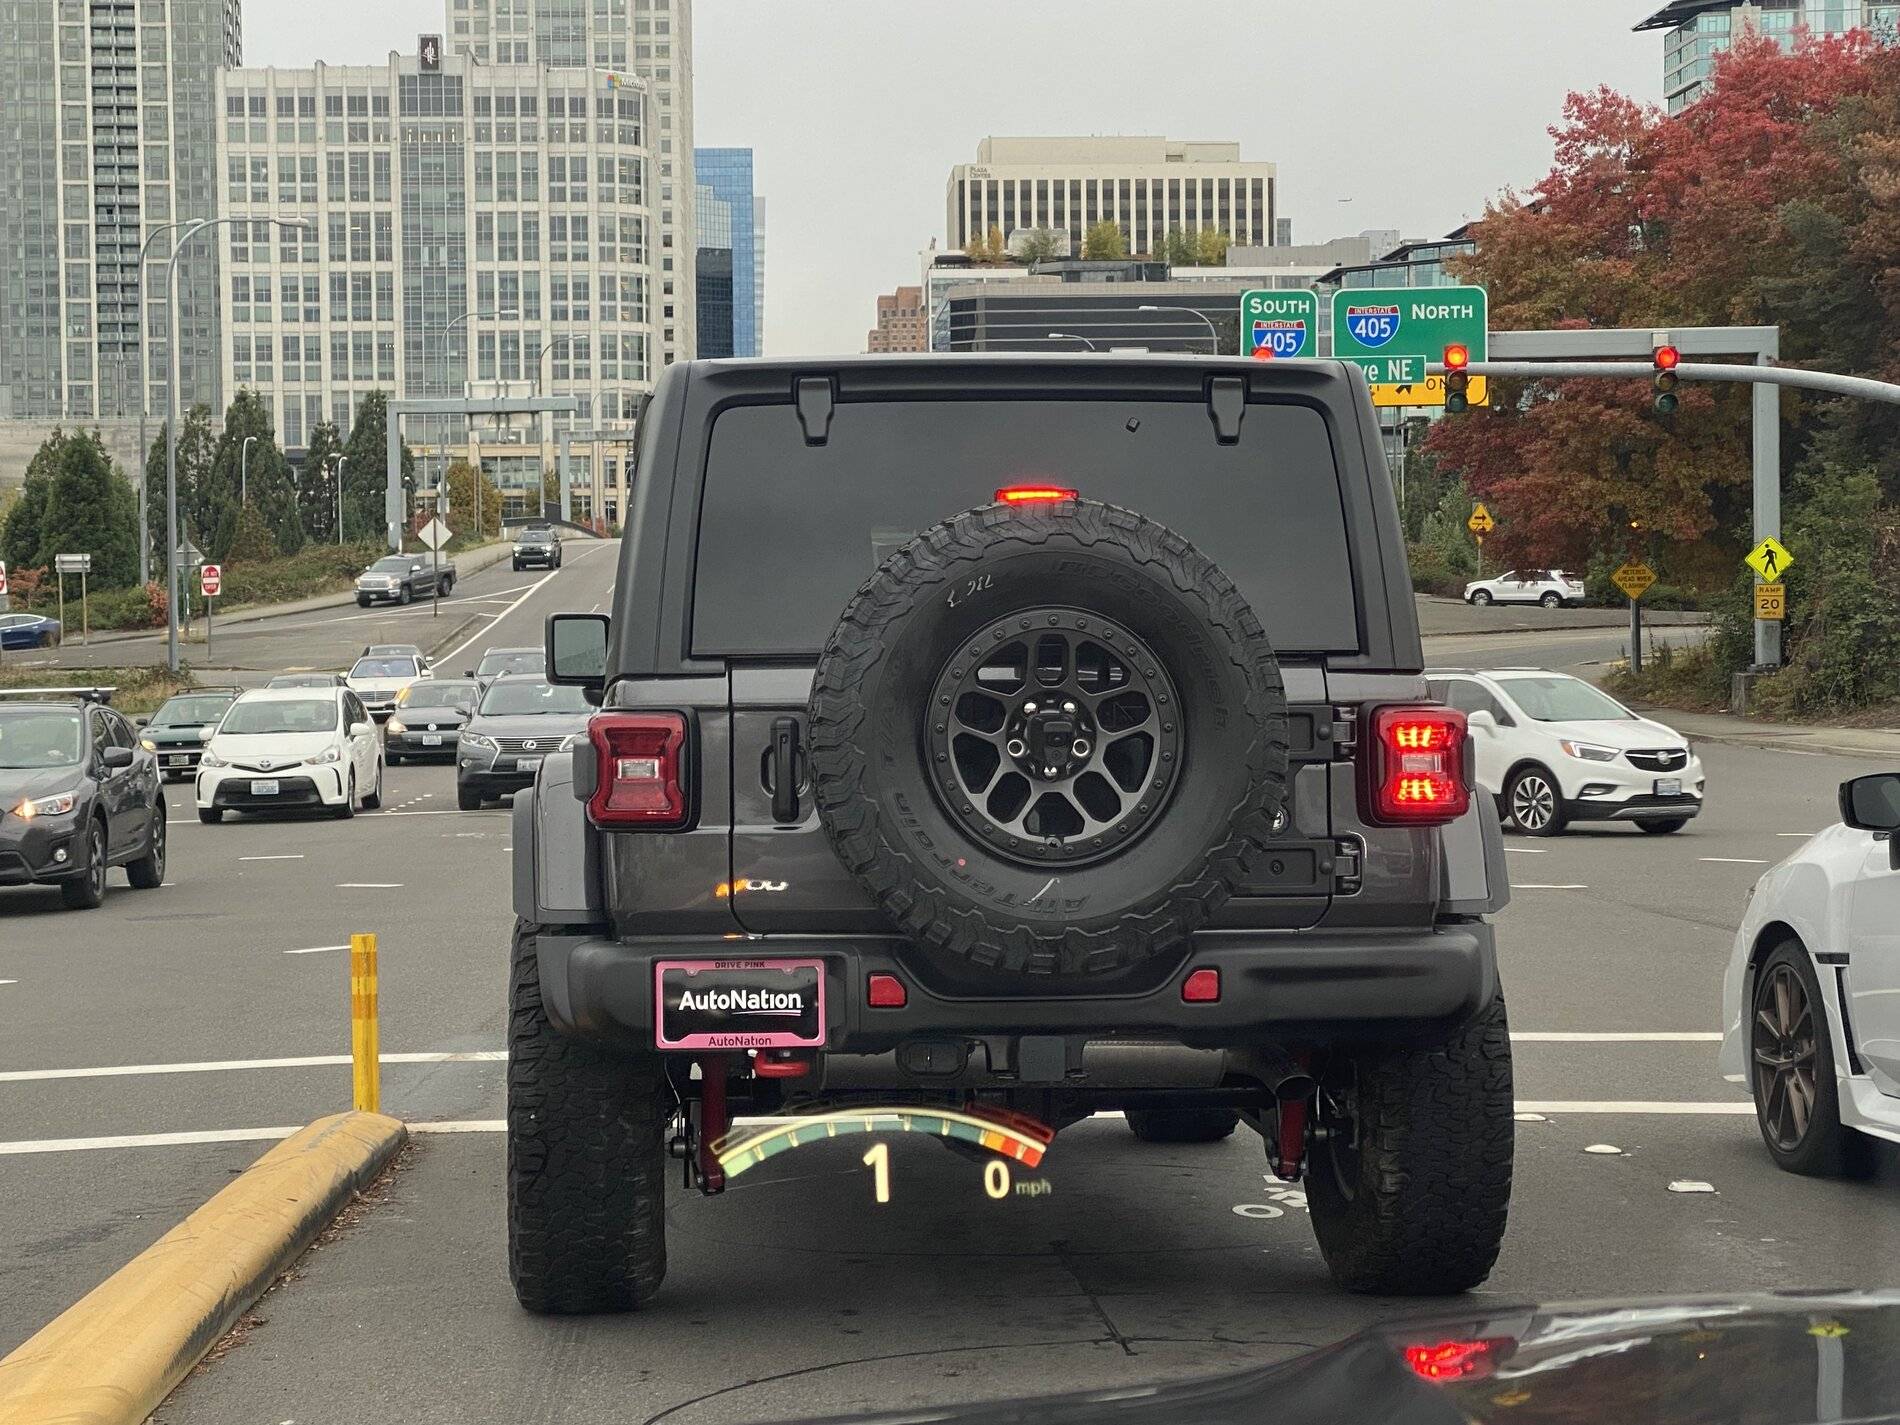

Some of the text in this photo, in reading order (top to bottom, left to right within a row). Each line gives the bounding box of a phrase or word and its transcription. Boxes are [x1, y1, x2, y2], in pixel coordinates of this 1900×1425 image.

[1249, 297, 1310, 314] SOUTH
[1354, 307, 1393, 315] INTERSTATE
[1411, 303, 1474, 320] NORTH
[1354, 317, 1392, 339] 405
[1260, 332, 1298, 353] 405
[1387, 359, 1413, 381] NE
[1760, 598, 1780, 610] 20
[714, 961, 742, 969] DRIVE
[678, 989, 803, 1011] AutoNation
[708, 1035, 772, 1047] AutoNation
[862, 1142, 890, 1203] 1
[984, 1160, 1052, 1200] 0 mph
